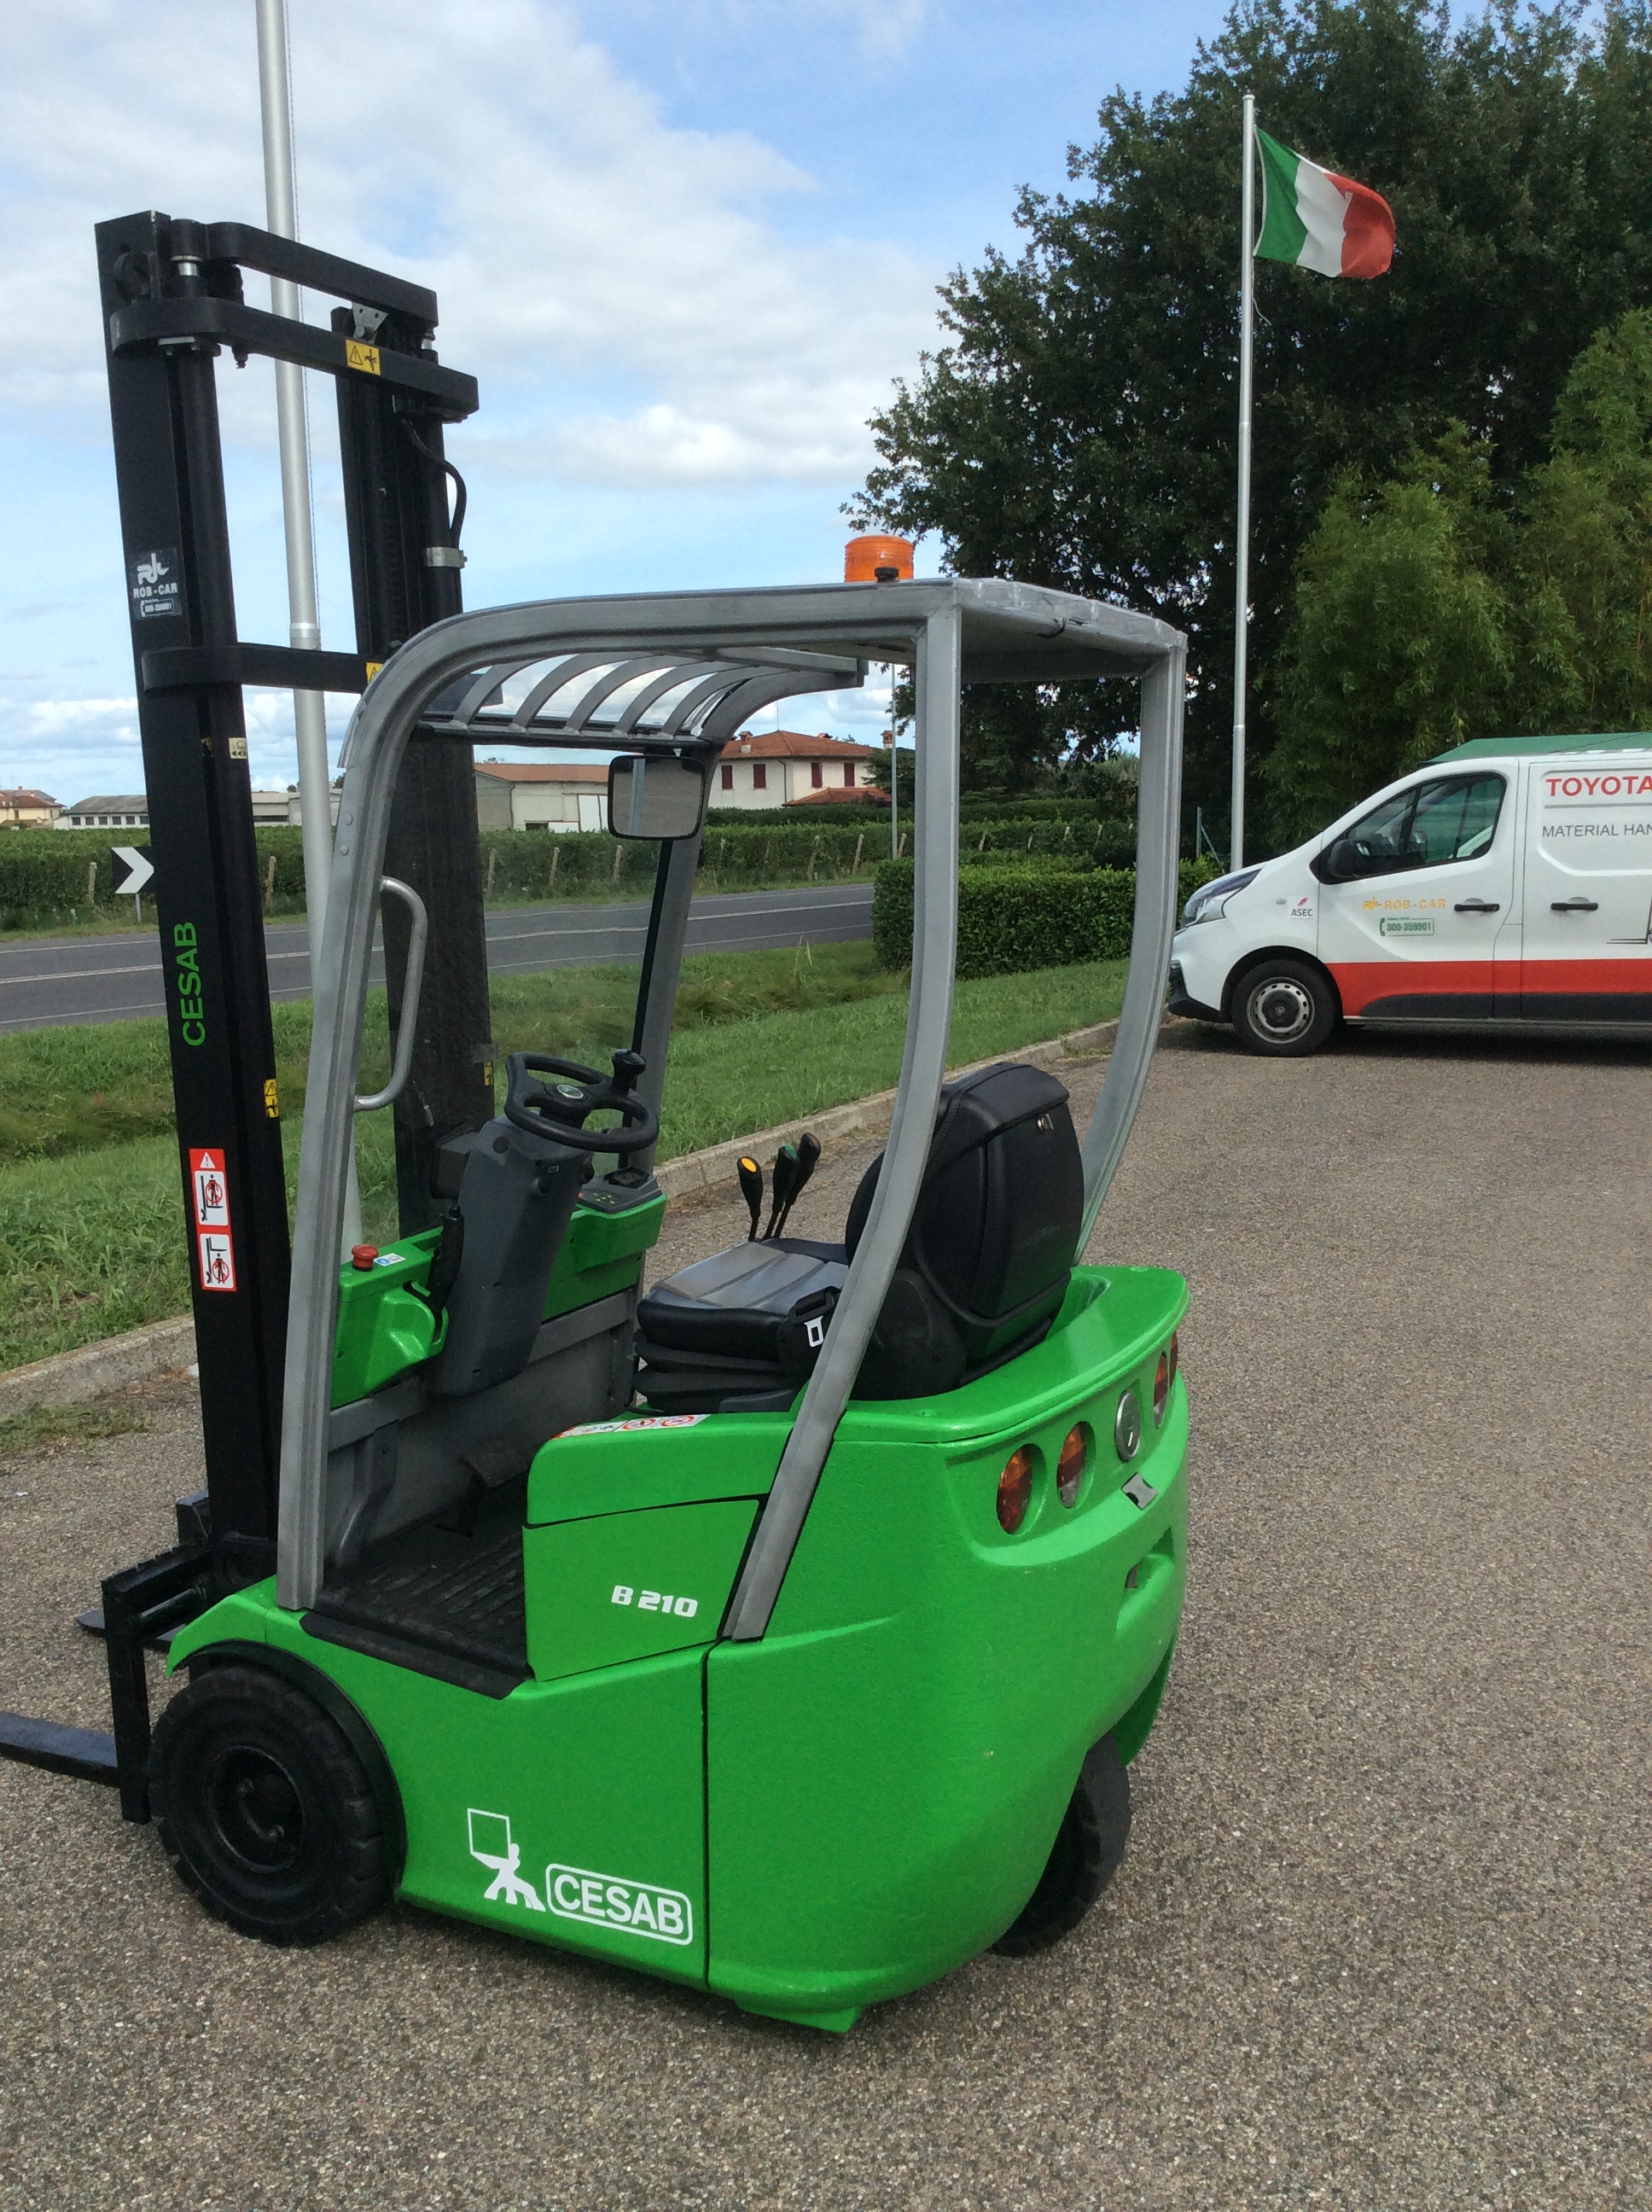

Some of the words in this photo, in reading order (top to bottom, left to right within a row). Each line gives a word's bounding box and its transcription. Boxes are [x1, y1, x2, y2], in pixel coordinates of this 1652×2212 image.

[1545, 776, 1652, 797] TOYOTA
[1542, 825, 1620, 837] MATERIAL
[1290, 908, 1313, 917] ASEC
[173, 922, 206, 1046] CESAB
[611, 1585, 634, 1606] B
[637, 1590, 698, 1618] 210
[554, 1874, 684, 1936] CESAB
